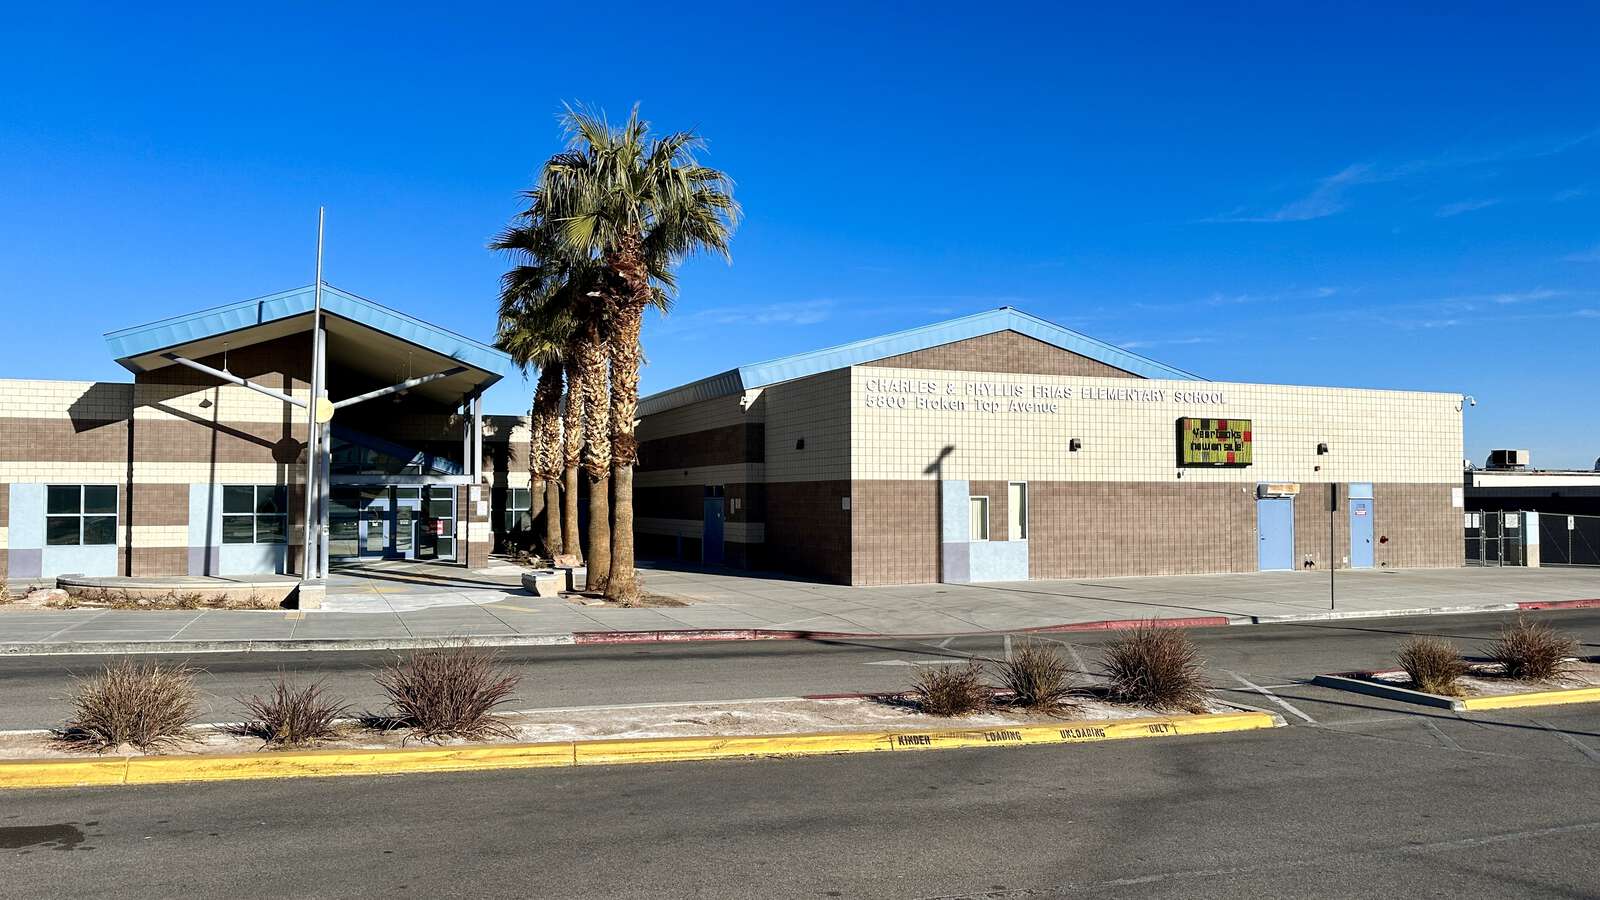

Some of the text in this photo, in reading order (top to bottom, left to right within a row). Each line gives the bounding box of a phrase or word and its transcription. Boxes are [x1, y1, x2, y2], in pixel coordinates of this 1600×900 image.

[866, 379, 1227, 405] CHARLES & PHYLLIS FRIAS ELEMENTARY SCHOOL
[866, 395, 1058, 414] 5800 Broken Top Avenue
[898, 735, 931, 746] KINDER
[984, 730, 1022, 742] LOADING
[1060, 727, 1106, 739] UNLOADING
[1149, 723, 1169, 734] ONLY
